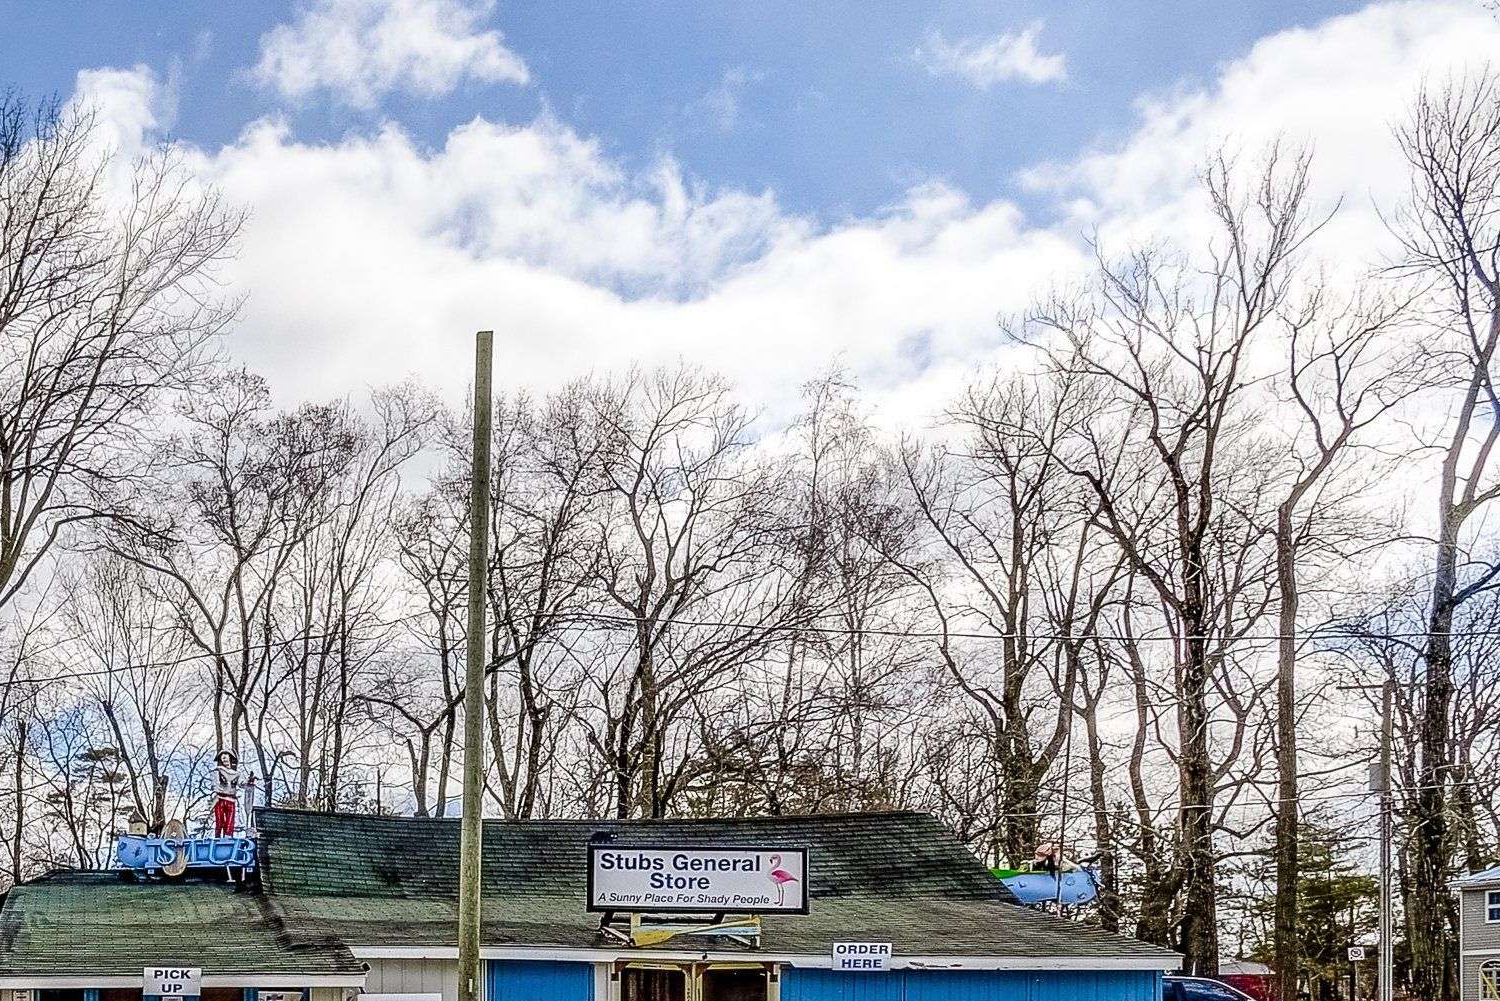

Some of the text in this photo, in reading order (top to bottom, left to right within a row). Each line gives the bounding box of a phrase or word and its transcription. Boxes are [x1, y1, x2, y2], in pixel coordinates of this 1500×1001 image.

[600, 852, 761, 872] Stubs General
[649, 872, 711, 890] Store
[598, 892, 770, 905] A Sunny Place For Shady People
[836, 944, 889, 955] ORDER
[841, 958, 882, 969] HERE
[153, 969, 191, 980] PICK
[161, 983, 183, 993] UP
